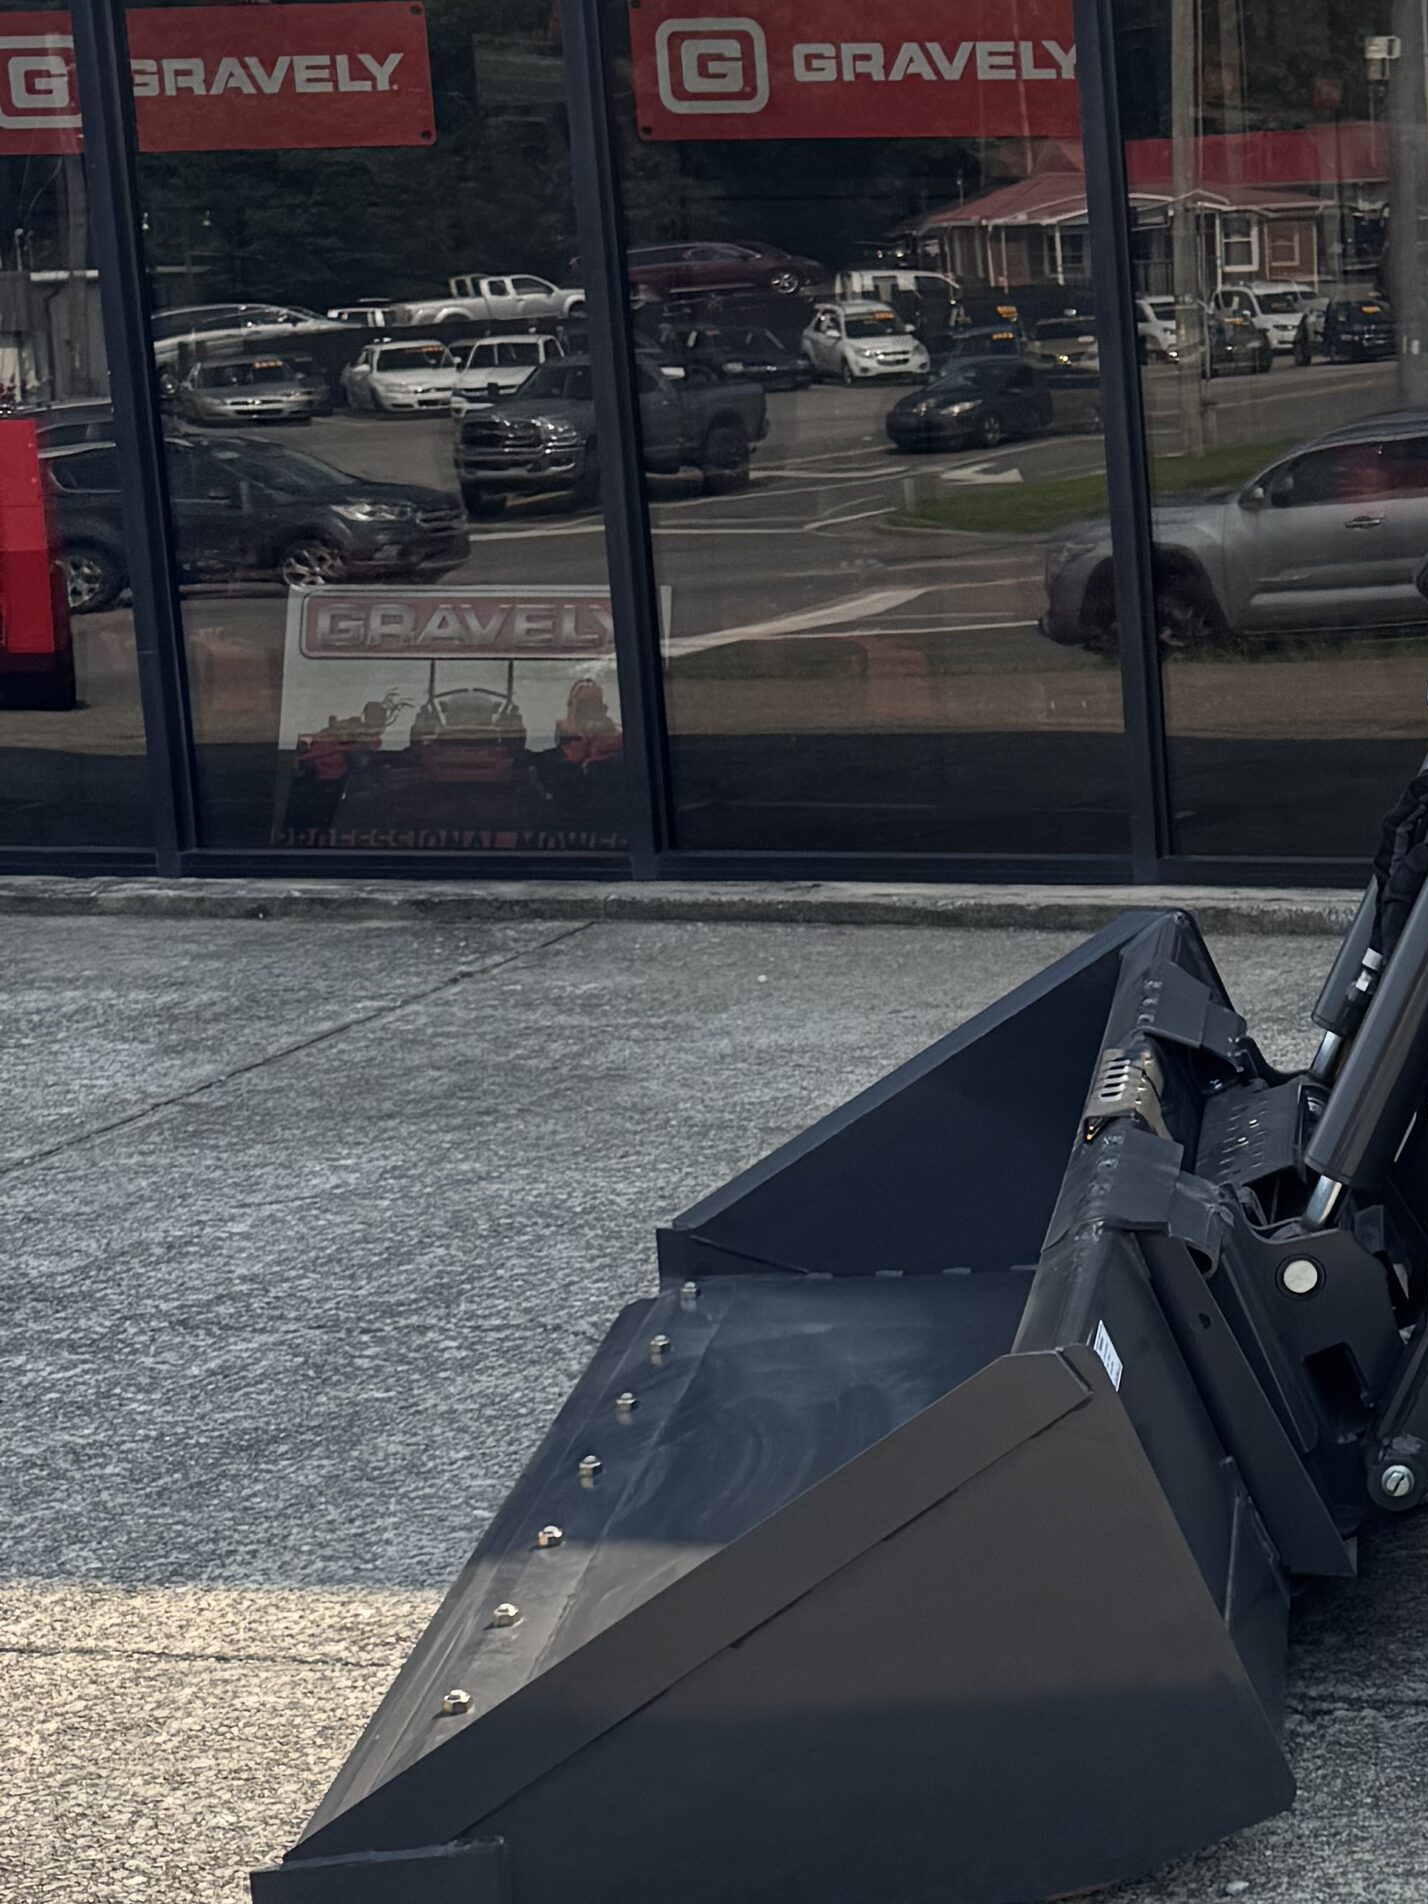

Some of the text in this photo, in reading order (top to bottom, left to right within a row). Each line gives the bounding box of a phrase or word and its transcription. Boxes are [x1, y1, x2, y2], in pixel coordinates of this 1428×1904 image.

[8, 53, 404, 109] G GRAVELY
[680, 39, 1077, 93] G GRAVELY
